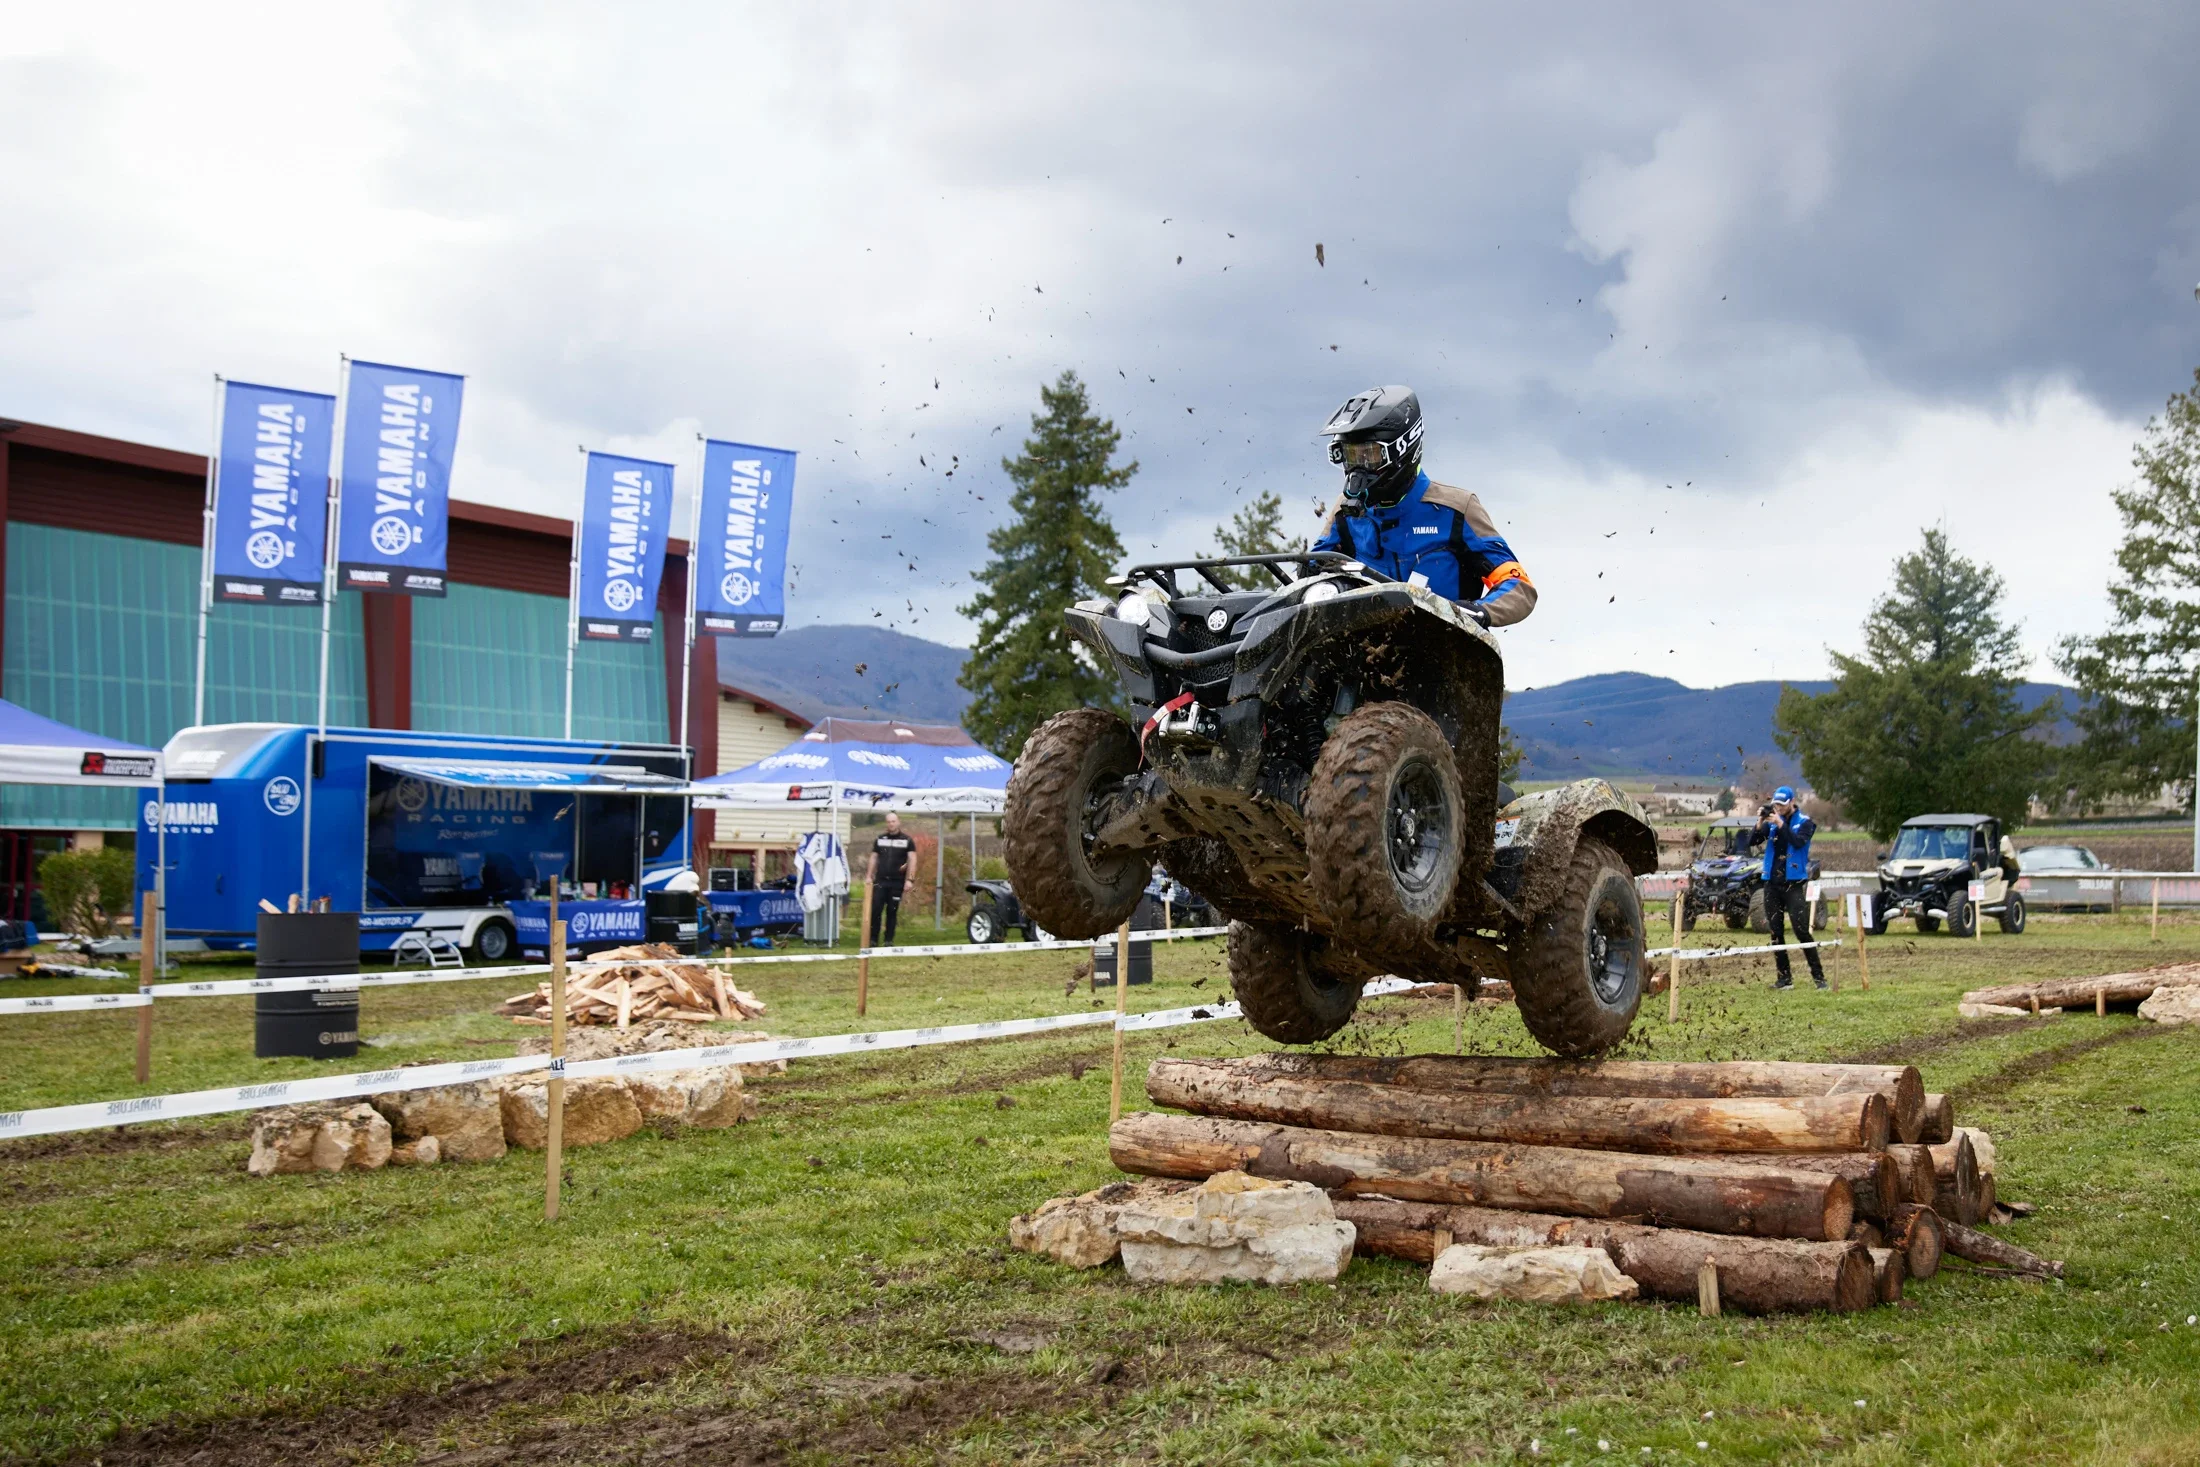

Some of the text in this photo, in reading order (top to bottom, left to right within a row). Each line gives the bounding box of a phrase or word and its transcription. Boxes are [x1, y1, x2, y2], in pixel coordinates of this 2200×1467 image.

[250, 404, 294, 529] YAMAHA
[285, 415, 305, 557] RACING
[375, 384, 420, 514] YAMAHA
[413, 396, 432, 543] RACING
[607, 471, 642, 578] YAMAHA
[635, 480, 652, 600] RACING
[724, 460, 761, 571] YAMAHA
[752, 469, 771, 595] RACING
[1413, 526, 1438, 534] YAMAHA
[407, 814, 527, 824] RACING
[431, 783, 533, 812] YAMAHA
[576, 930, 636, 939] RACING
[590, 912, 640, 930] YAMAHA
